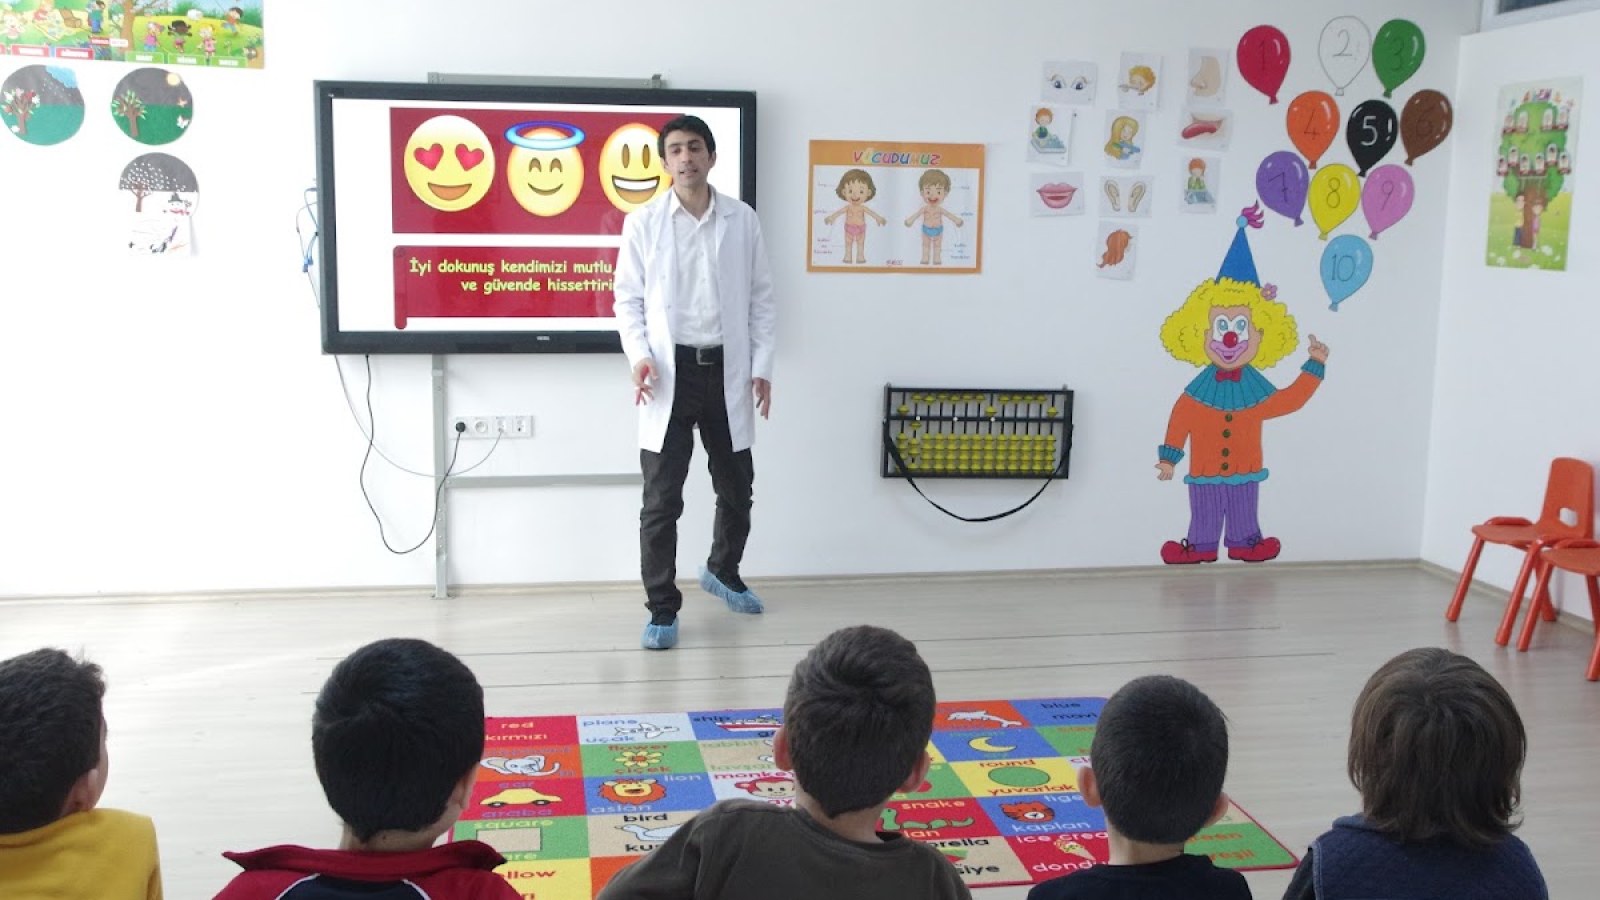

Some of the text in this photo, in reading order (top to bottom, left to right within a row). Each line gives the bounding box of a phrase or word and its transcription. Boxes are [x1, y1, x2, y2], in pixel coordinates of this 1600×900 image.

[1332, 29, 1352, 57] 2
[1390, 37, 1405, 72] 3
[1303, 108, 1319, 140] 4
[1415, 105, 1434, 137] 6
[1360, 115, 1378, 146] 5
[1267, 171, 1288, 203] 7
[1326, 177, 1341, 209] 8
[1381, 180, 1394, 211] 9
[409, 257, 432, 276] İyi
[438, 259, 494, 276] dokunuş
[501, 259, 567, 274] kendimizi
[1331, 254, 1356, 282] 10
[461, 279, 614, 295] ve güvende hissettiri
[501, 721, 534, 729] red
[583, 719, 637, 727] plane
[586, 735, 634, 744] uçak
[979, 760, 1036, 769] round
[664, 774, 702, 782] lion
[498, 781, 533, 789] car
[987, 784, 1077, 796] yuvarlak
[1043, 794, 1084, 803] tige
[591, 804, 654, 814] aslan
[901, 800, 966, 810] snake
[482, 809, 553, 818] araba
[623, 813, 668, 823] bird
[473, 820, 554, 829] square
[1011, 821, 1091, 833] kaplan
[903, 830, 941, 838] lan
[1015, 831, 1109, 844] ice crea
